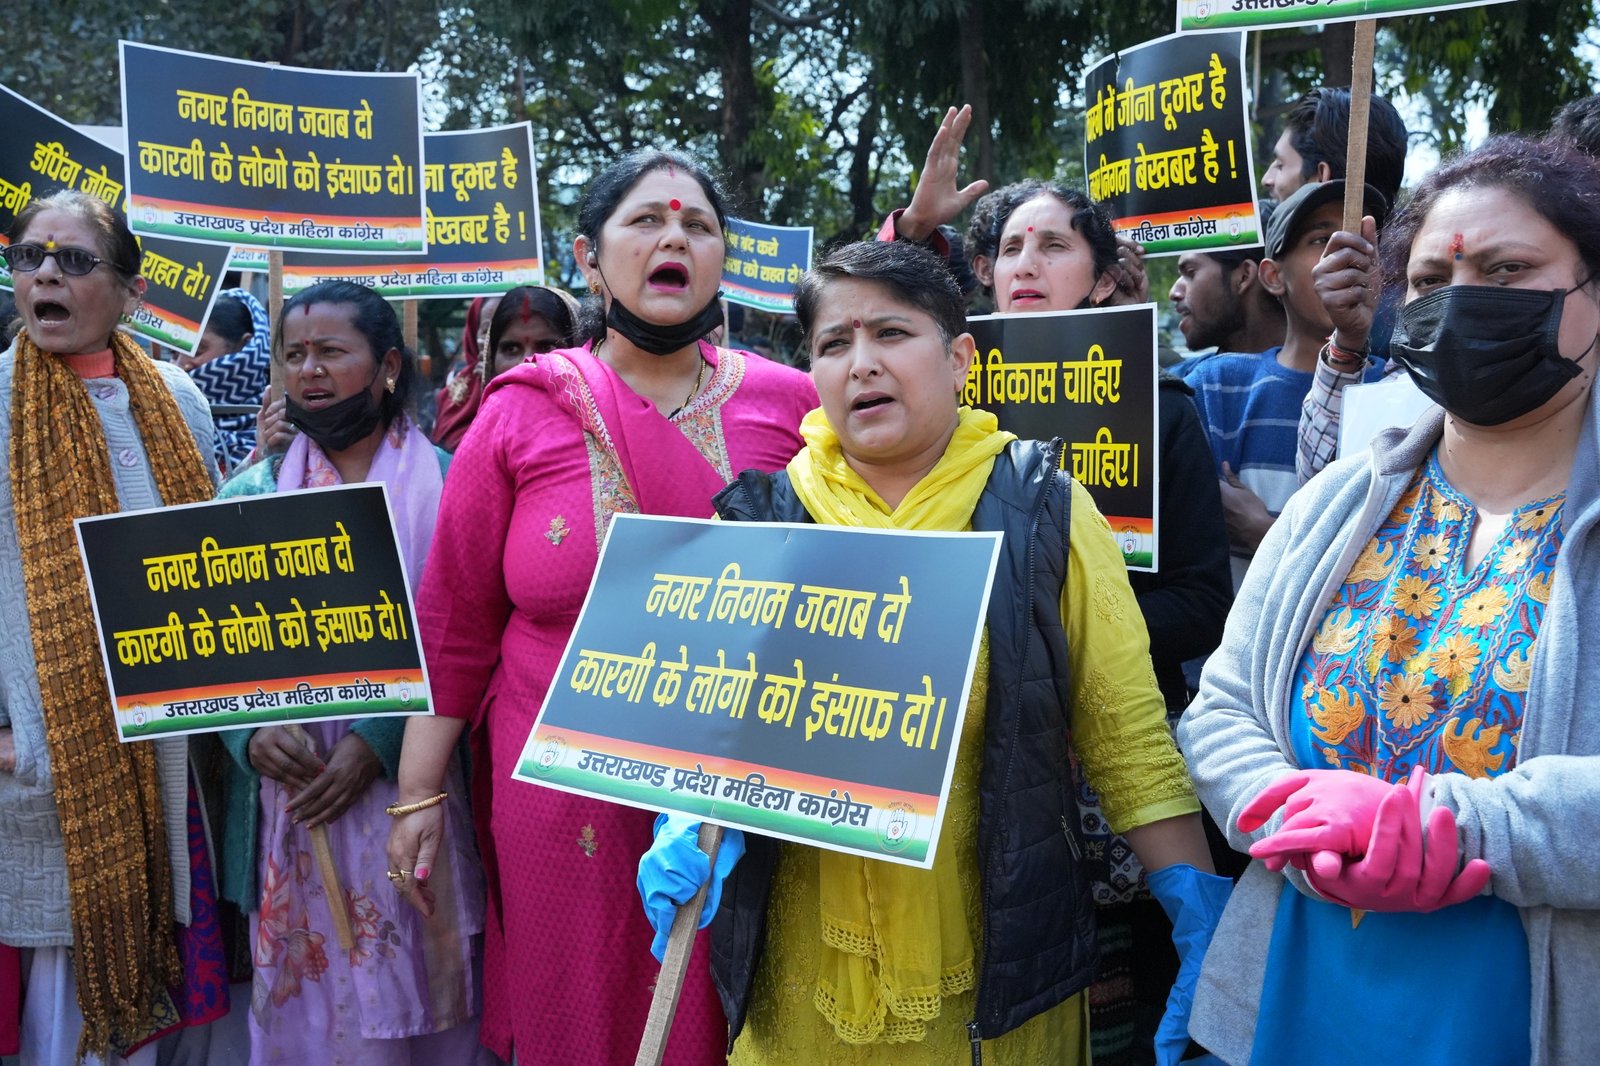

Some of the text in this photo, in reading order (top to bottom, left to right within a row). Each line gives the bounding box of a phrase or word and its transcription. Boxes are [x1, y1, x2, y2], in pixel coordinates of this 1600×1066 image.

[177, 87, 373, 139] नगर निगम जवाब दो
[1103, 84, 1116, 132] में
[1116, 77, 1156, 126] जीना
[1159, 73, 1204, 131] दूभर
[1208, 52, 1227, 110] है
[81, 164, 124, 209] जोन
[138, 138, 205, 180] कारगी
[210, 142, 233, 183] के
[237, 145, 288, 189] लोगो
[293, 150, 321, 192] को
[325, 157, 382, 199] इंसाफ
[424, 147, 518, 201] ना दूभर है
[1134, 143, 1197, 191] बेखबर
[1200, 128, 1220, 184] है
[0, 178, 32, 217] रगी
[426, 206, 489, 245] बेखबर
[493, 202, 511, 243] है
[174, 211, 384, 242] उत्तराखण्ड प्रदेश महिला कांग्रेस
[1131, 221, 1169, 242] महिला
[1173, 216, 1216, 238] कांग्रेस
[140, 250, 184, 290] राहत
[379, 270, 411, 287] प्रदेश
[415, 269, 457, 285] महिला
[462, 268, 503, 284] कांग्रेस
[960, 344, 1122, 406] ही विकास चाहिए
[142, 521, 355, 593] नगर निगम जवाब दो
[645, 562, 912, 644] नगर निगम जवाब दो
[113, 611, 188, 667] कारगी
[188, 607, 216, 658] के
[218, 600, 275, 655] लोगो
[275, 597, 310, 649] को
[310, 600, 375, 653] इंसाफ
[163, 677, 387, 718] उत्तराखण्ड प्रदेश महिला कांग्रेस
[570, 641, 657, 704] कारगी
[652, 645, 689, 707] के
[686, 649, 758, 720] लोगो
[757, 659, 806, 728] को
[804, 673, 899, 742] इंसाफ
[577, 748, 873, 828] उत्तराखण्ड प्रदेश महिला कांग्रेस
